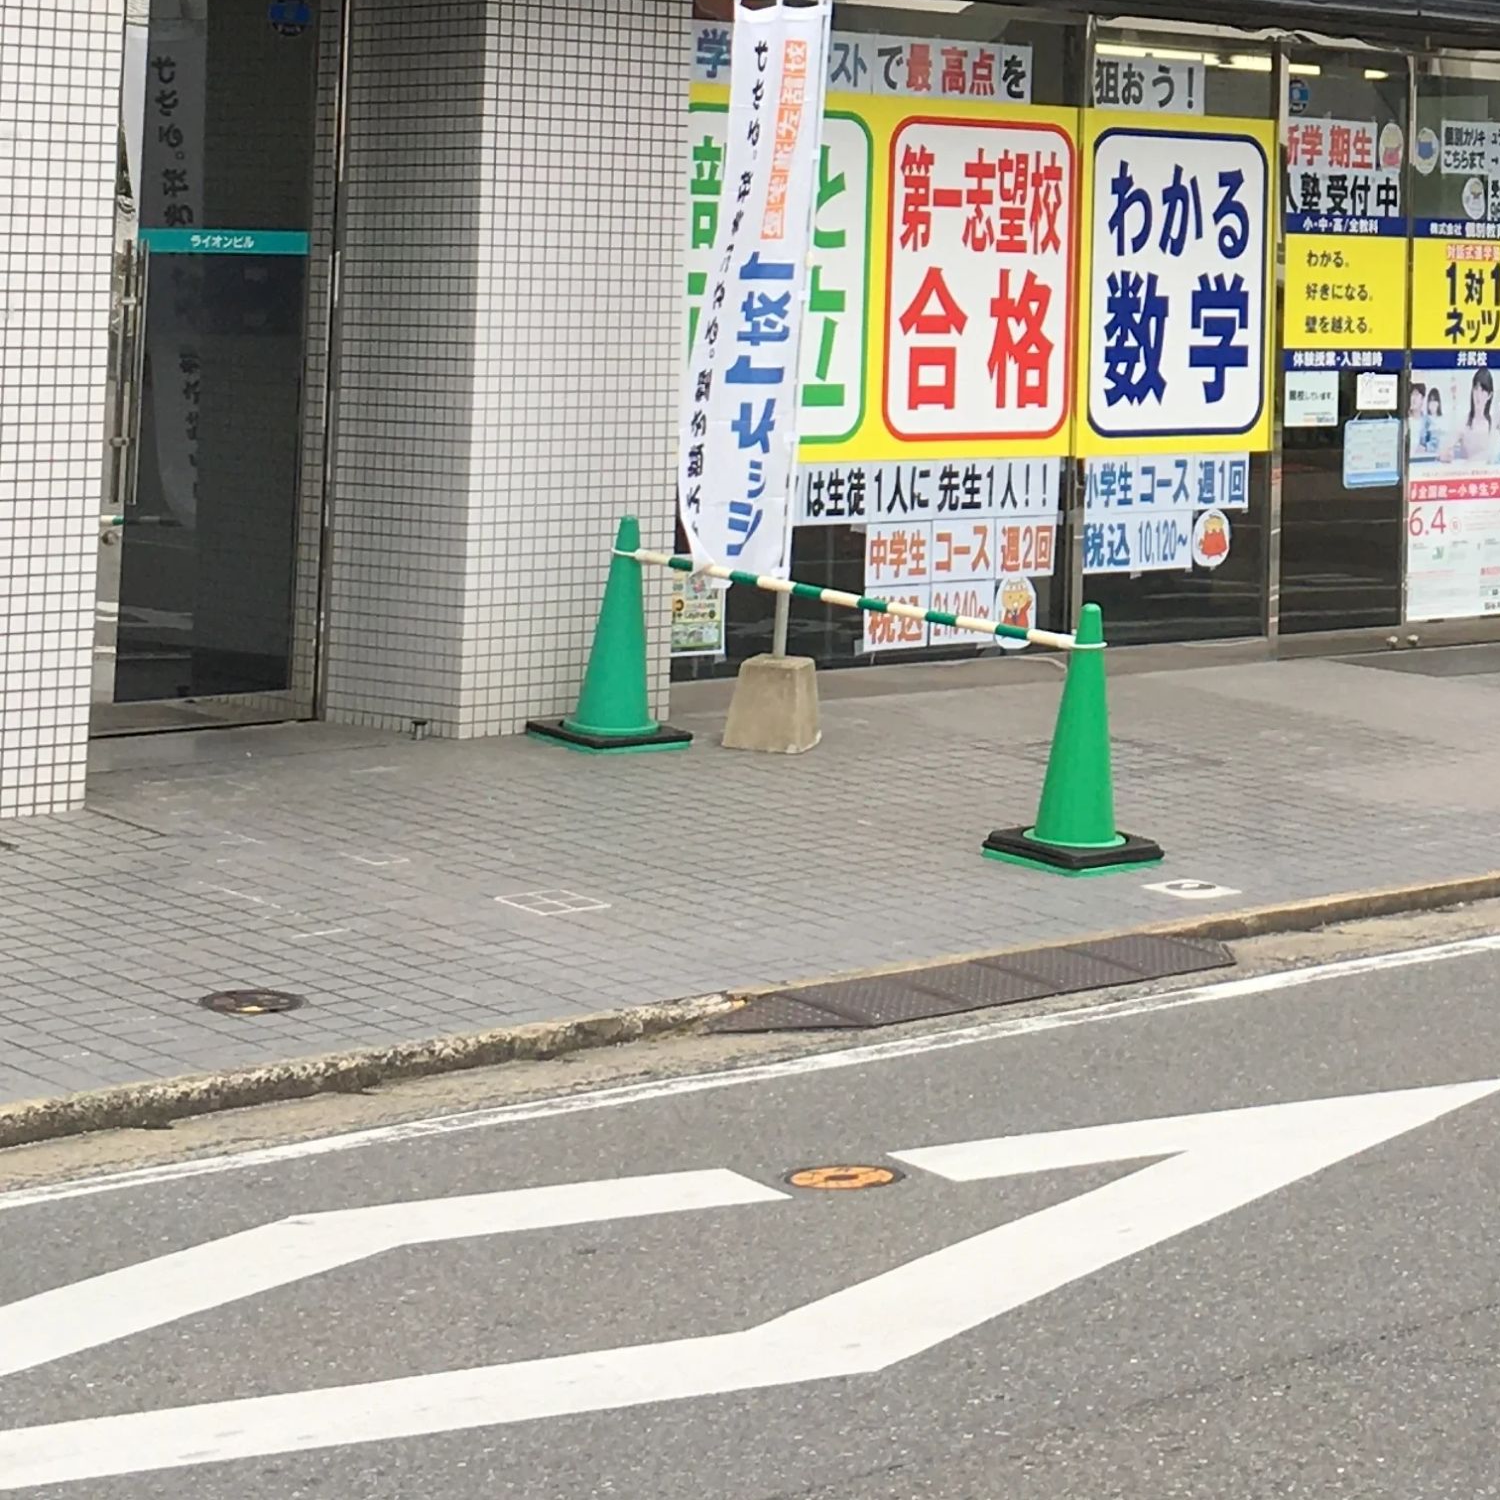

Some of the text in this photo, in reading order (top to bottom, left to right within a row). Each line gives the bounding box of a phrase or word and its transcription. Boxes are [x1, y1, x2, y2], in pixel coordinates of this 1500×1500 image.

[830, 42, 1027, 100] ストで最高点を
[899, 143, 1064, 256] 第一志望校
[1108, 159, 1250, 260] わかる
[190, 235, 255, 249] ライオンビル
[1306, 249, 1350, 268] わかる。
[1306, 283, 1373, 301] 好きになる。
[898, 266, 1055, 411] 合格
[1103, 270, 1250, 408] 数学
[1305, 315, 1373, 334] 壁を越える。
[1444, 307, 1500, 345] ネッツ
[797, 461, 1049, 518] は生徒1人に先生1人!!
[1408, 505, 1447, 537] 6.4
